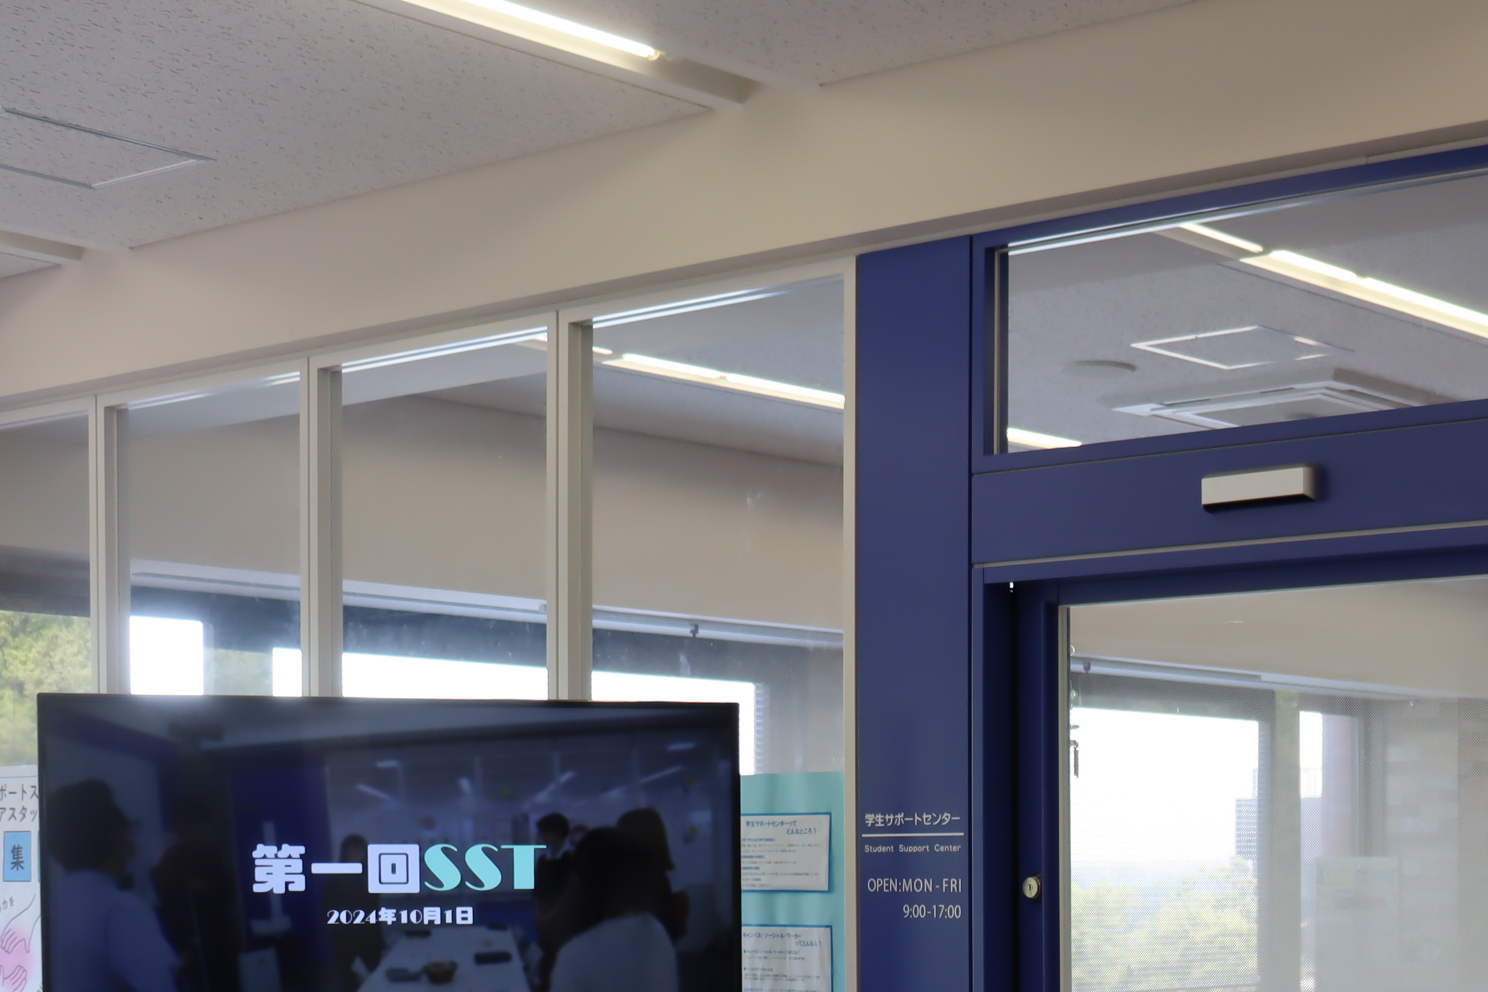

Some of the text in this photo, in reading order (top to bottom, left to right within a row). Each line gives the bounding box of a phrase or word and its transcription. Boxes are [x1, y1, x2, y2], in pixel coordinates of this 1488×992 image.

[864, 812, 961, 827] 学生サポートセンター
[864, 843, 962, 853] Student Support Center
[10, 844, 25, 872] 集
[252, 843, 547, 895] 第一回SST
[942, 878, 962, 893] FRI
[327, 906, 474, 926] 2024年10月1日
[902, 904, 962, 919] 9:00-17:00
